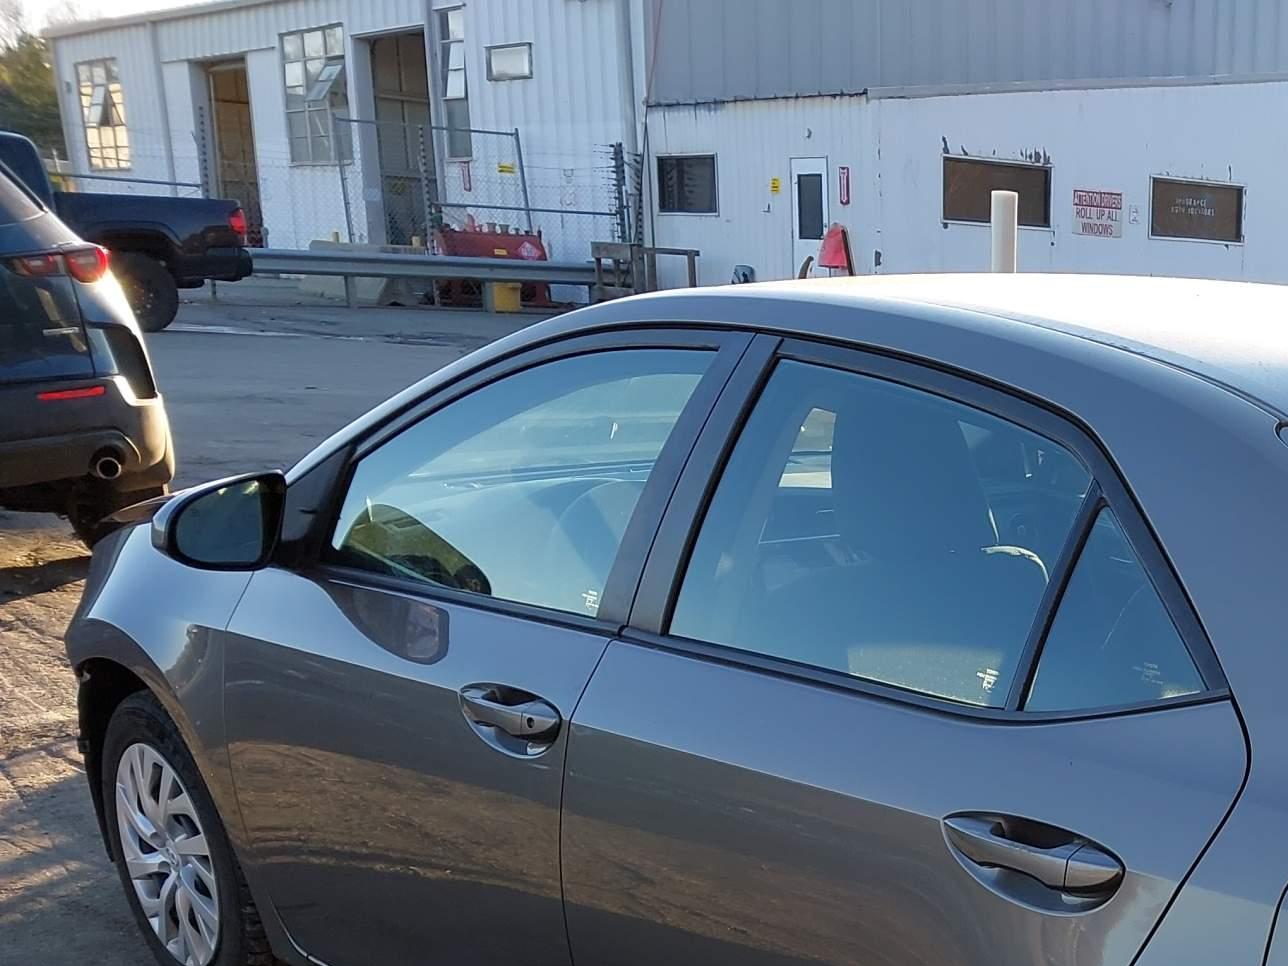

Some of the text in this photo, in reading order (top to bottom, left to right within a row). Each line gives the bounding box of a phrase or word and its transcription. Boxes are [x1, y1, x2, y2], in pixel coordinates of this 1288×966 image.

[1075, 207, 1093, 219] ROLL
[1096, 208, 1105, 220] UP
[1107, 209, 1119, 222] ALL
[1081, 222, 1113, 236] WINDOWS
